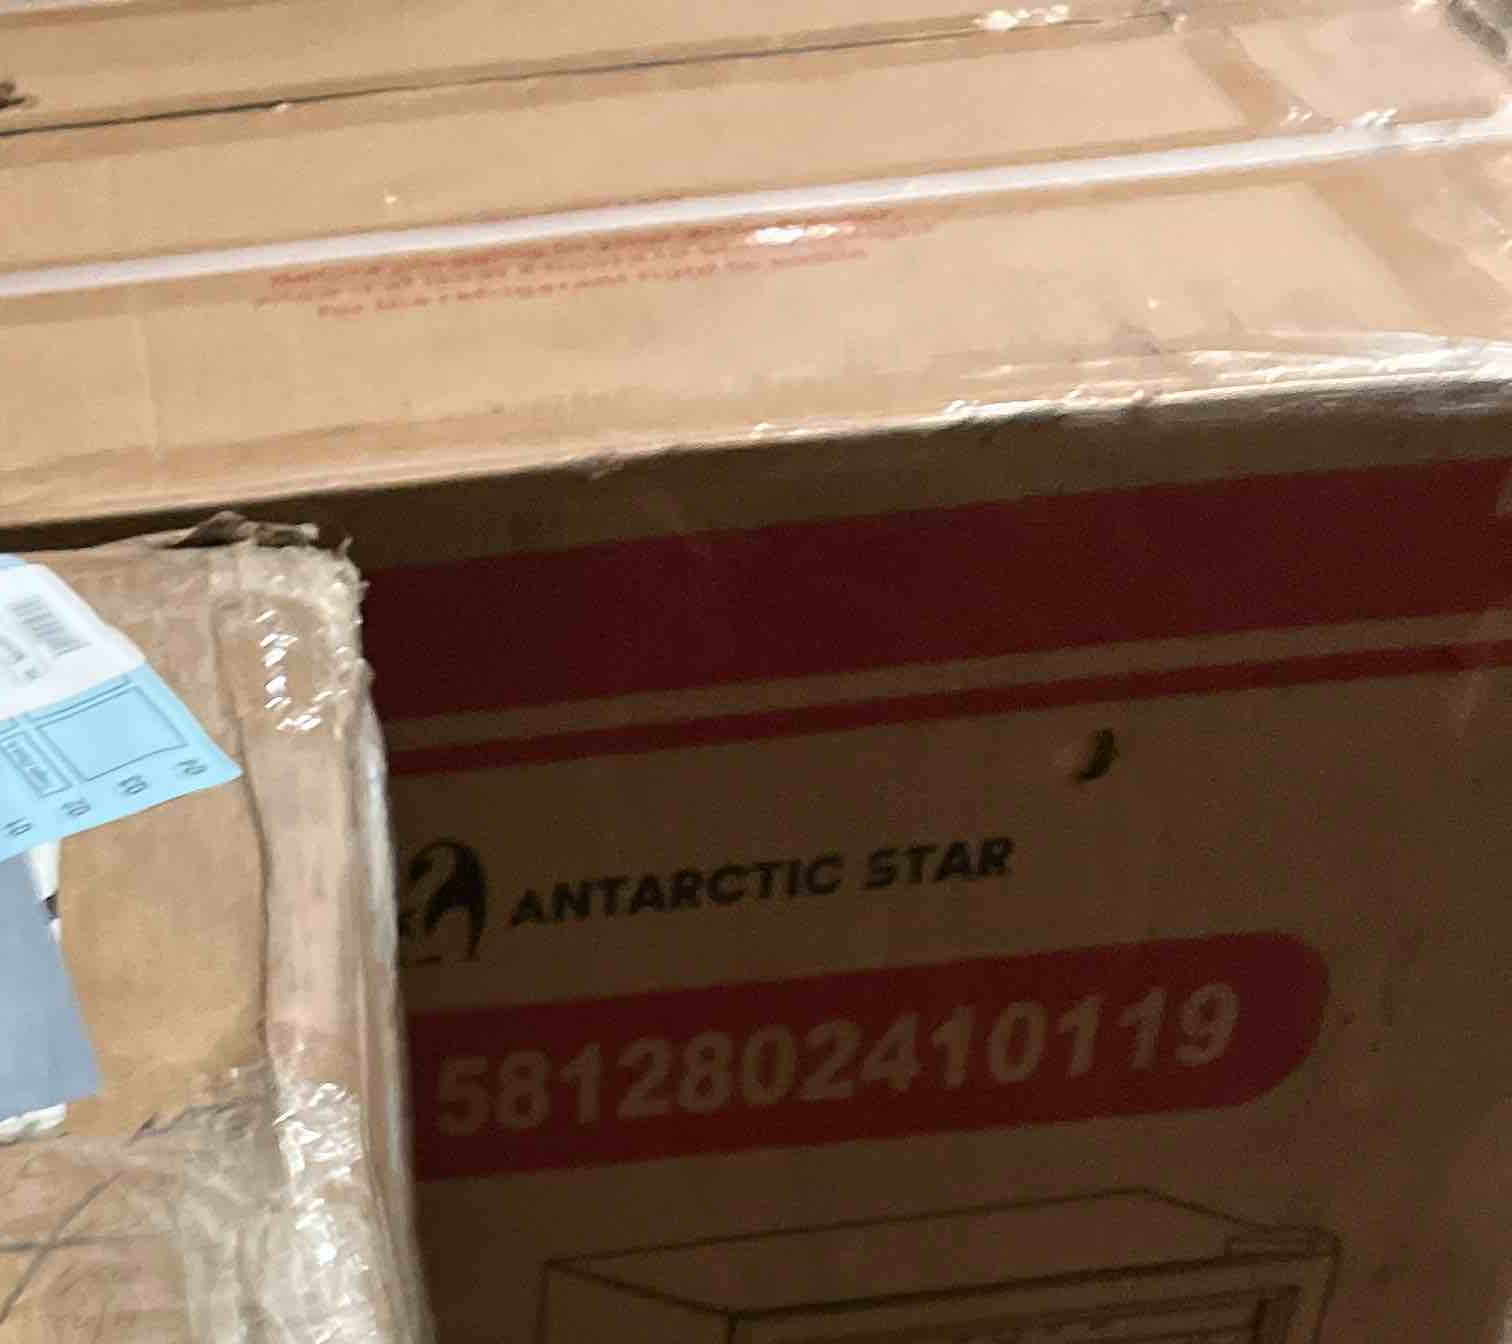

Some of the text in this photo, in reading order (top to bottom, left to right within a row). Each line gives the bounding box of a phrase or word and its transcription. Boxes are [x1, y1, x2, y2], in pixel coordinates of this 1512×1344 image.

[506, 836, 1015, 928] ANTARCTIC STAR
[435, 981, 1242, 1136] 5812802410119
